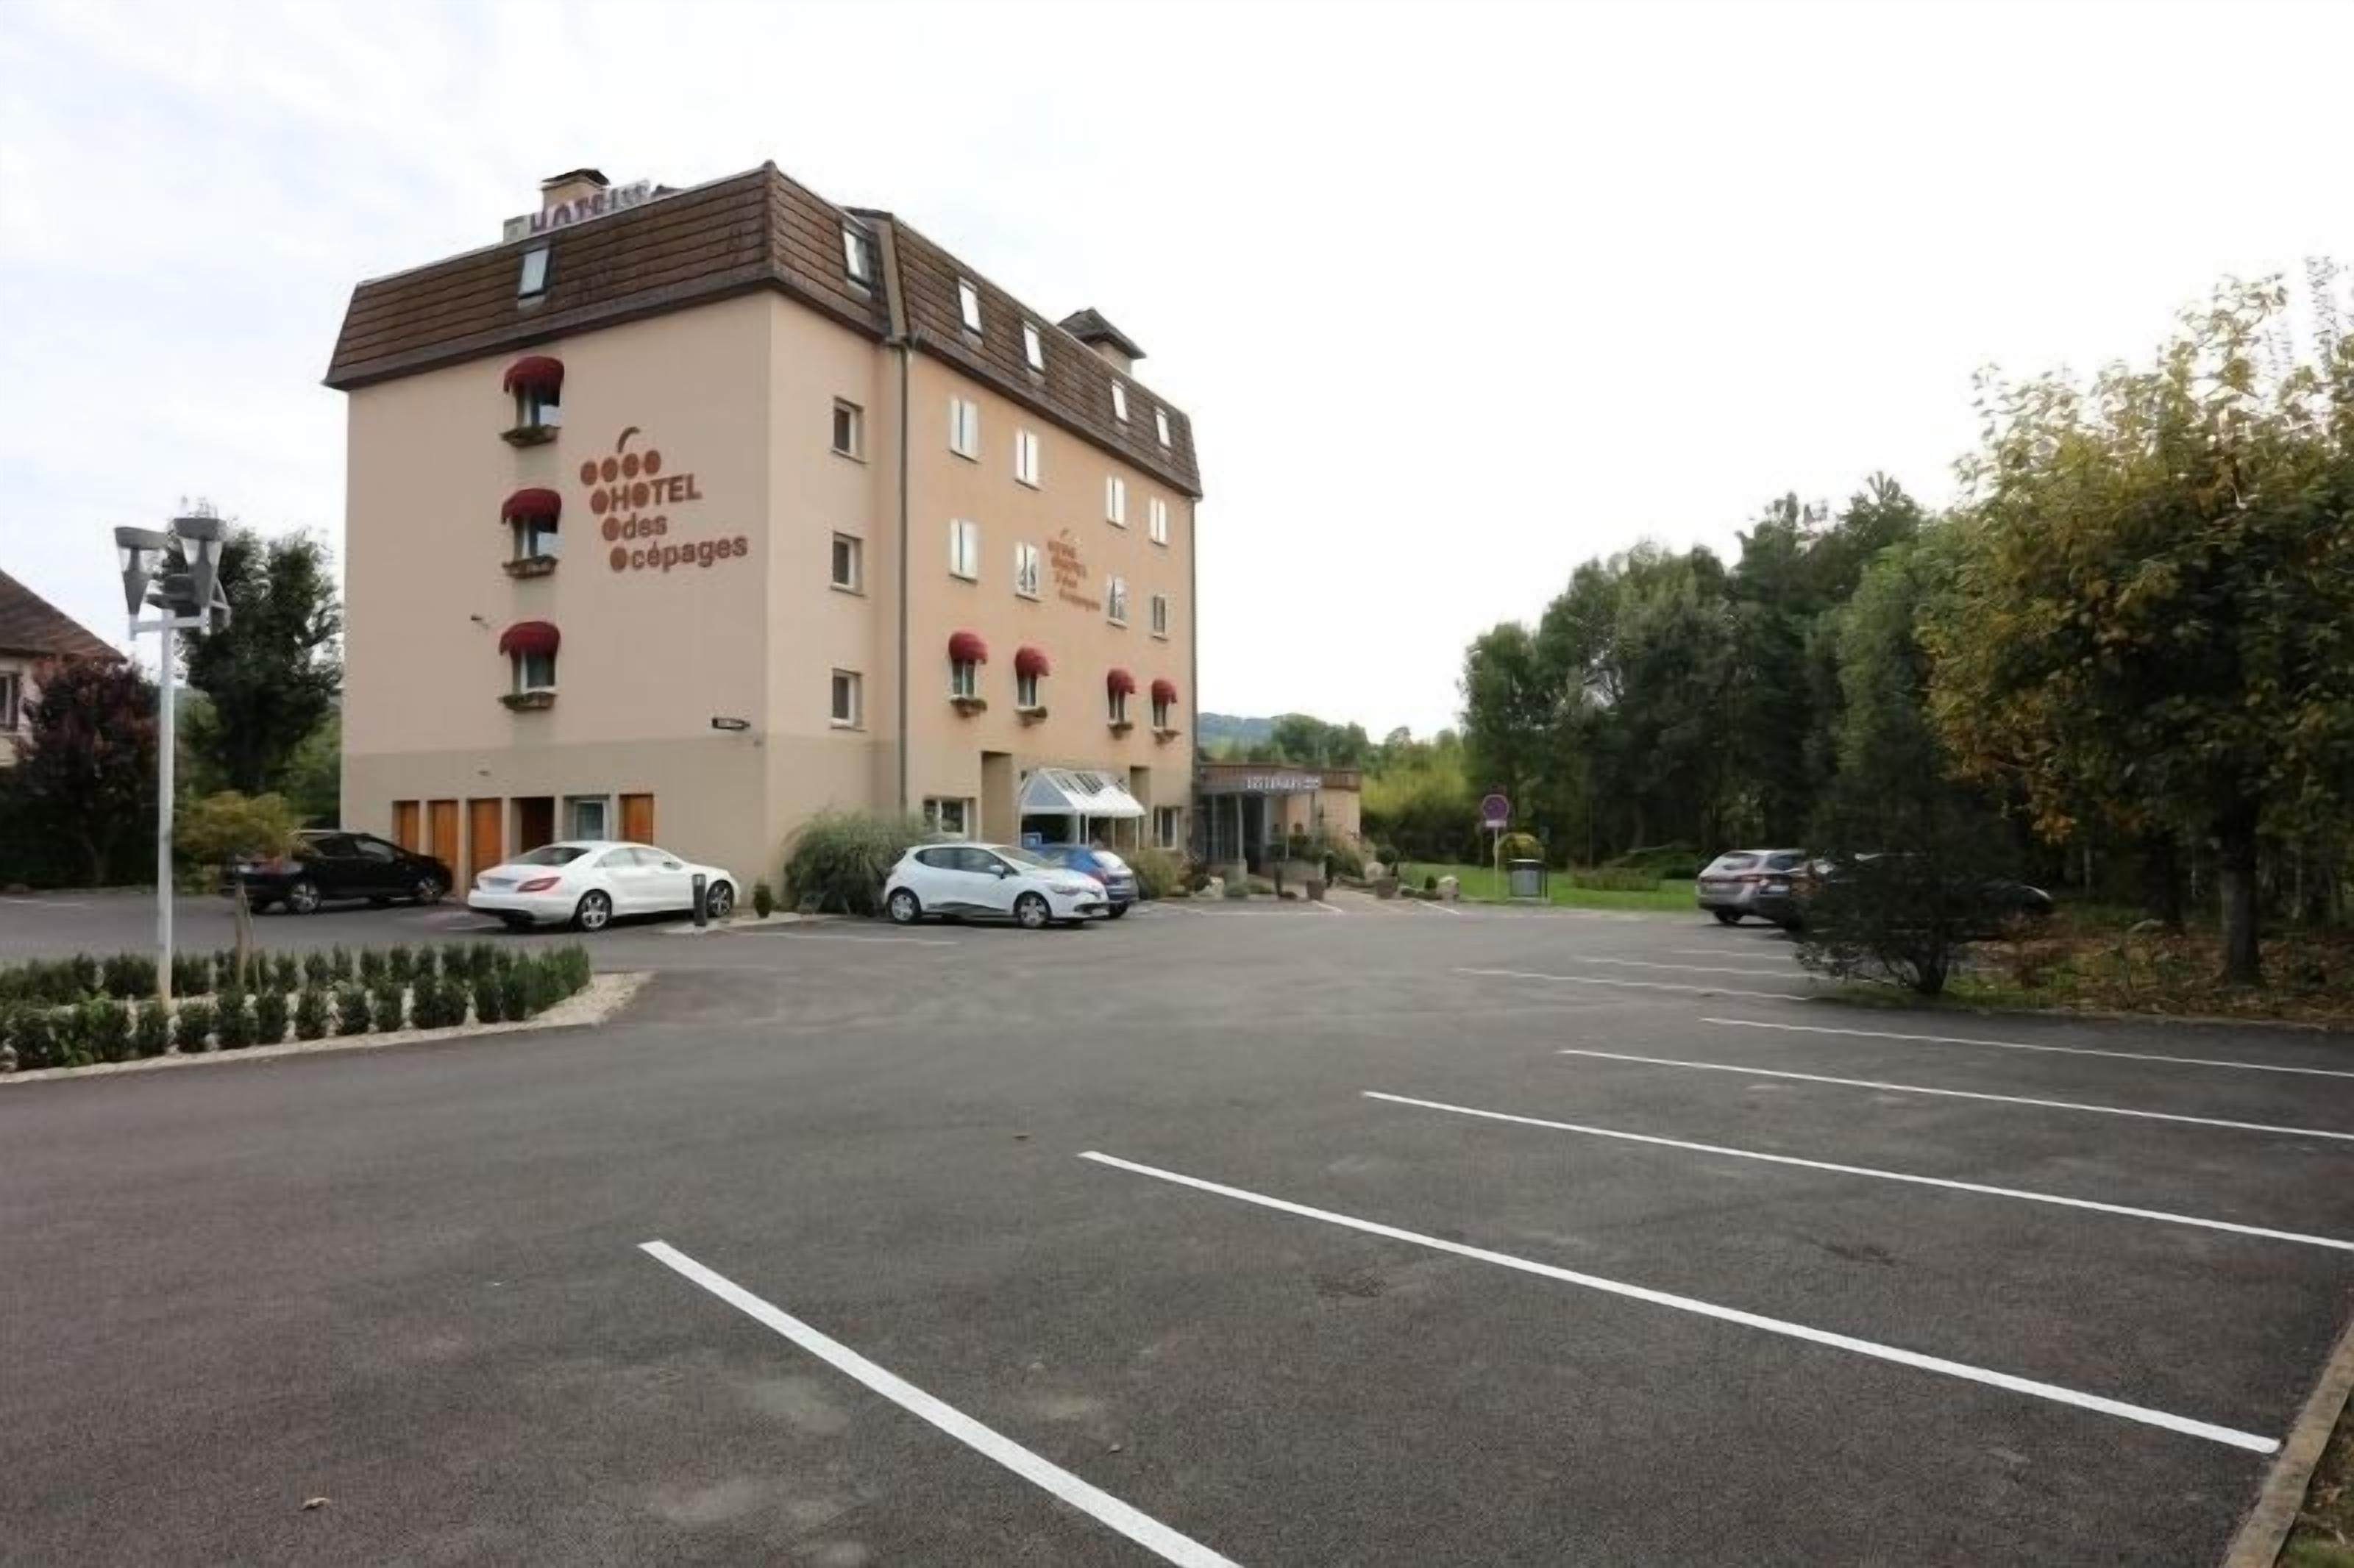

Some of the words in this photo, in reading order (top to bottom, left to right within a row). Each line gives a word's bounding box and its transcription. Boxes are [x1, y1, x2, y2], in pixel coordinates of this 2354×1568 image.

[610, 473, 703, 512] HOTEL
[622, 512, 667, 541] des
[632, 535, 747, 573] cépages
